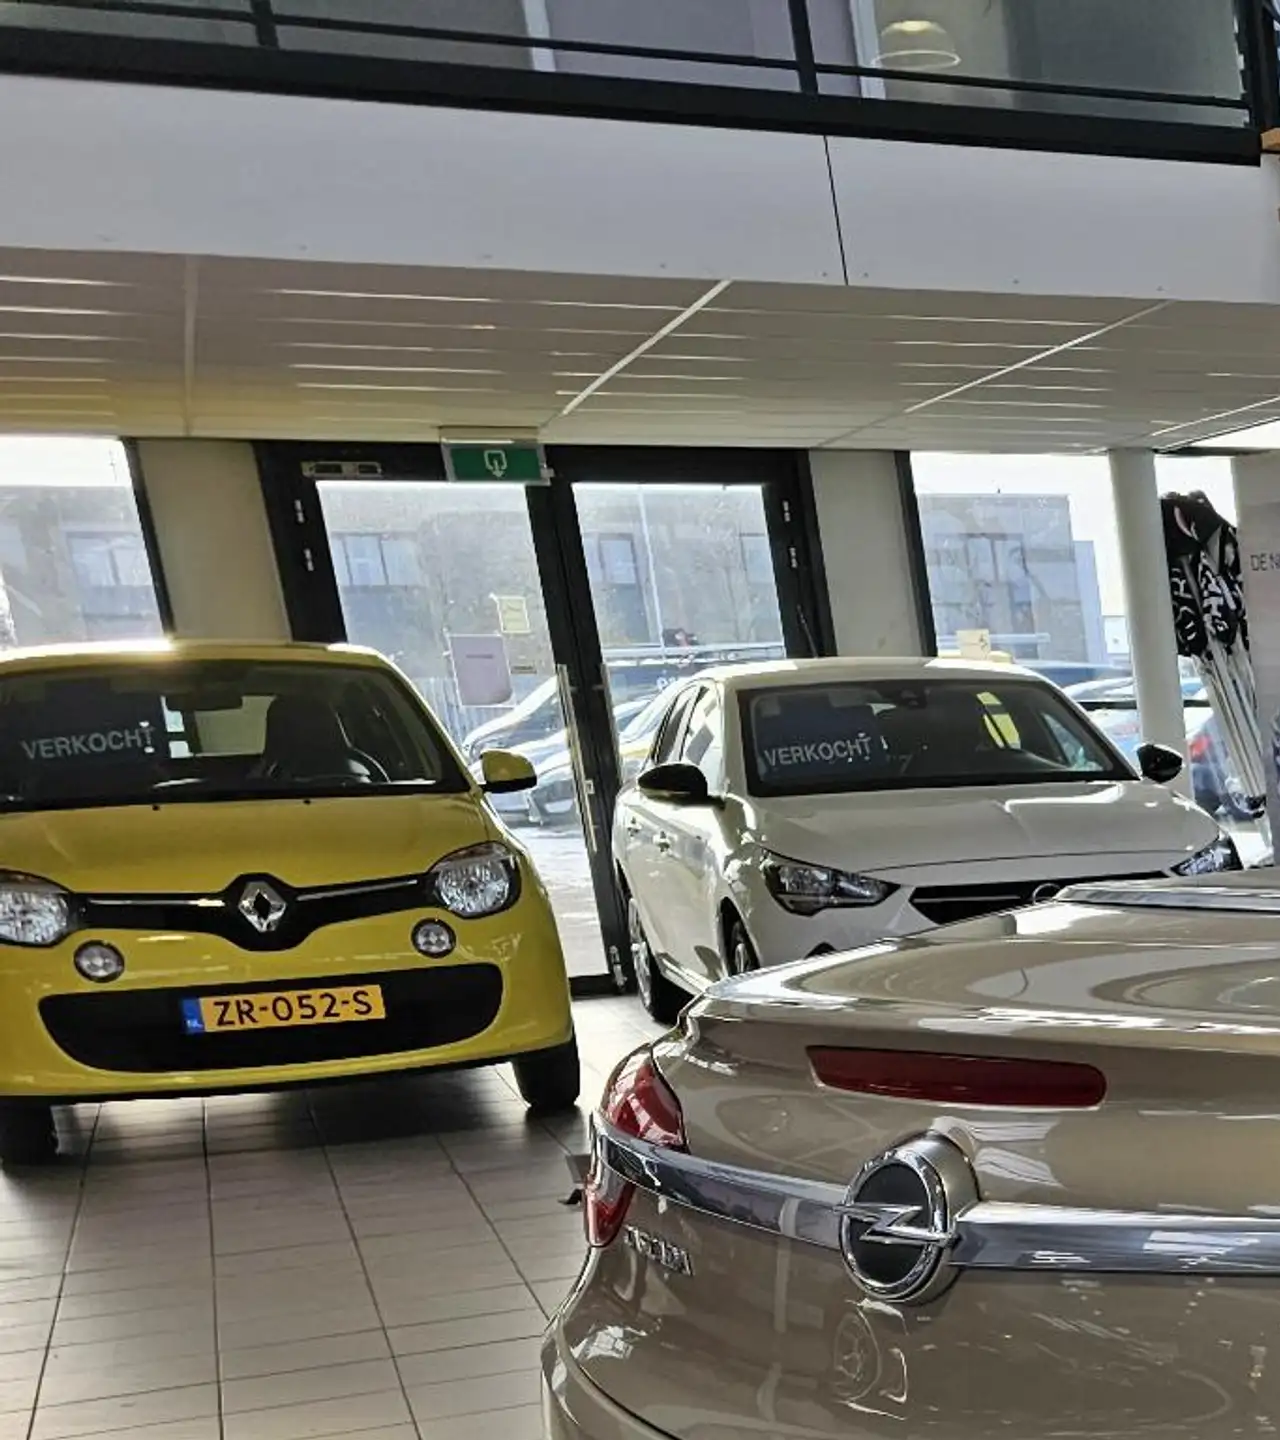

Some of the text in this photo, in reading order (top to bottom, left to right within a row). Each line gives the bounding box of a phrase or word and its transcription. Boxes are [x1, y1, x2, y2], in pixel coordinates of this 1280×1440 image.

[1250, 553, 1268, 571] DE
[20, 727, 155, 760] VERKOCHT
[764, 736, 871, 767] VERKOCHT
[213, 990, 373, 1026] ZR-052-S
